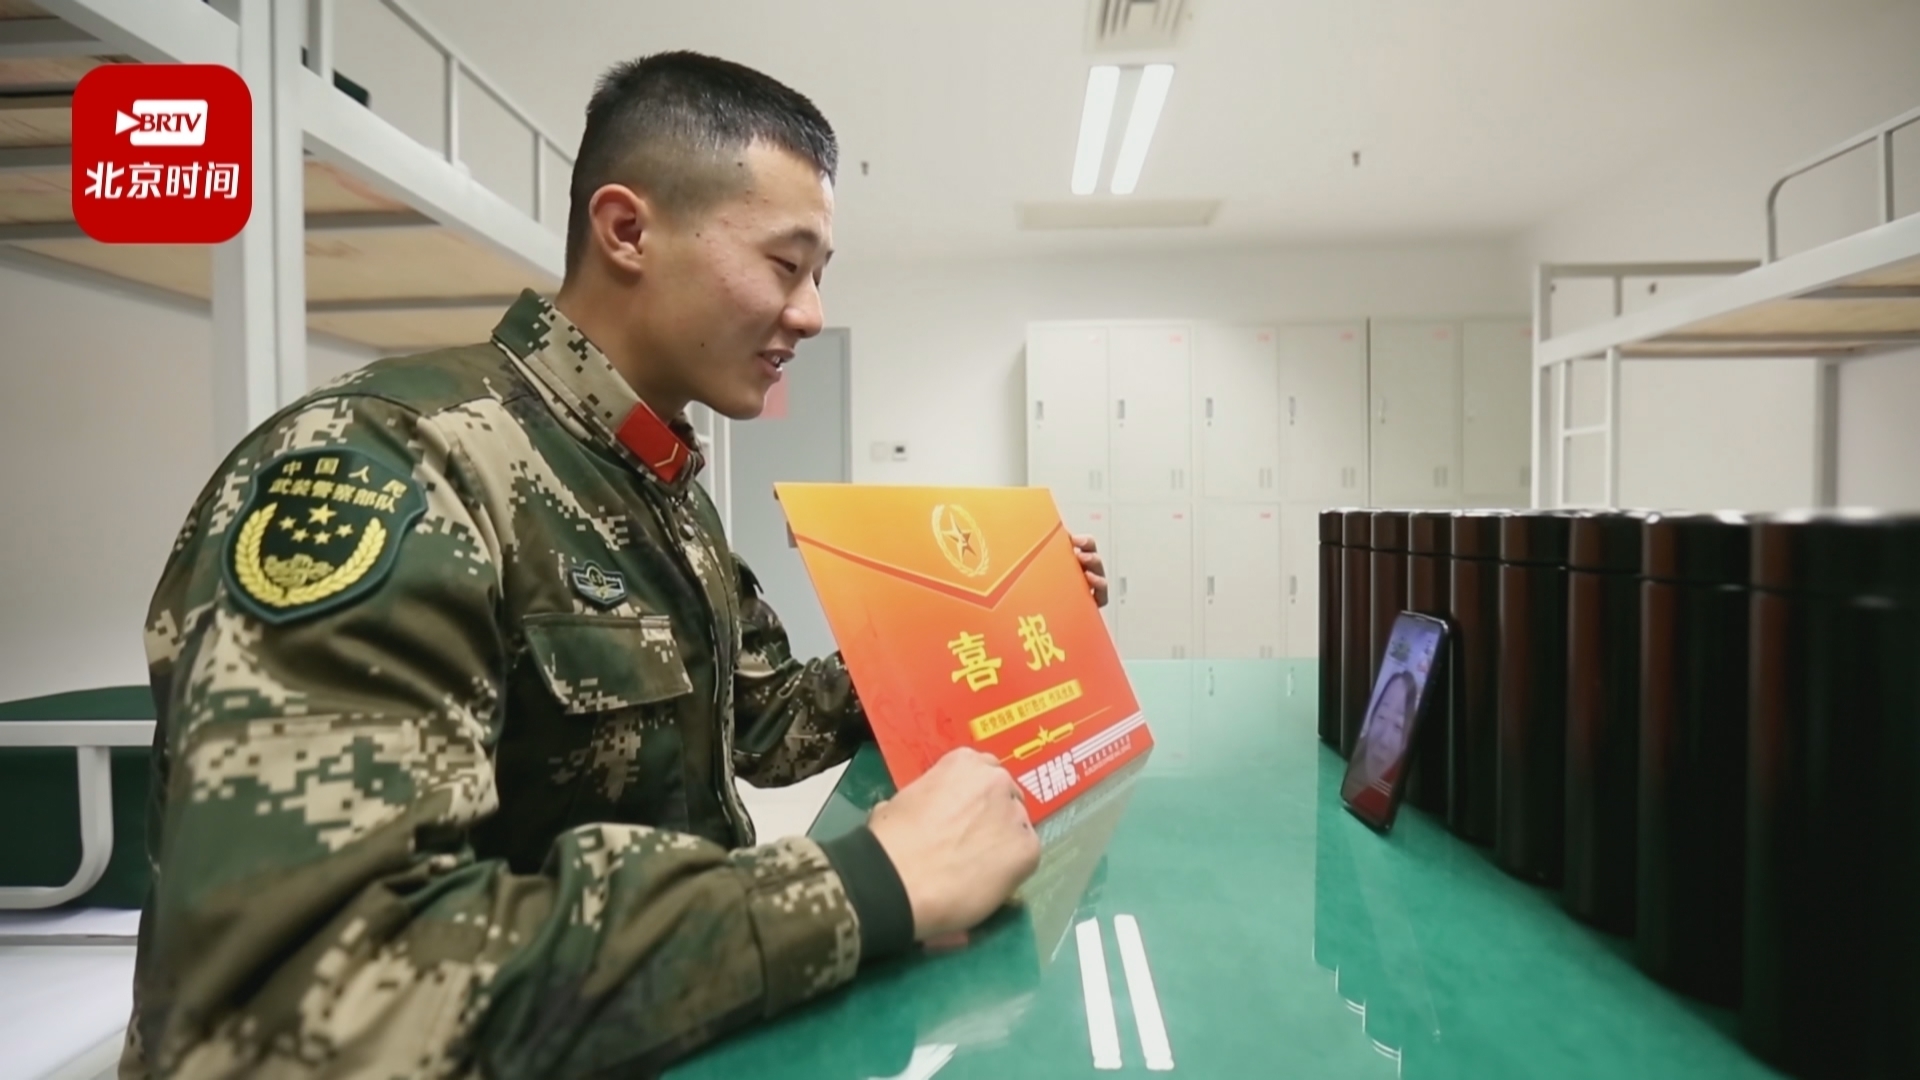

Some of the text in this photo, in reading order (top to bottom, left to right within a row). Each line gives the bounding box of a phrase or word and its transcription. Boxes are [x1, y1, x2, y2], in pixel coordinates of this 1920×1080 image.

[282, 457, 407, 498] 中国人民
[947, 614, 1066, 692] 喜报
[1037, 750, 1078, 804] EMS
